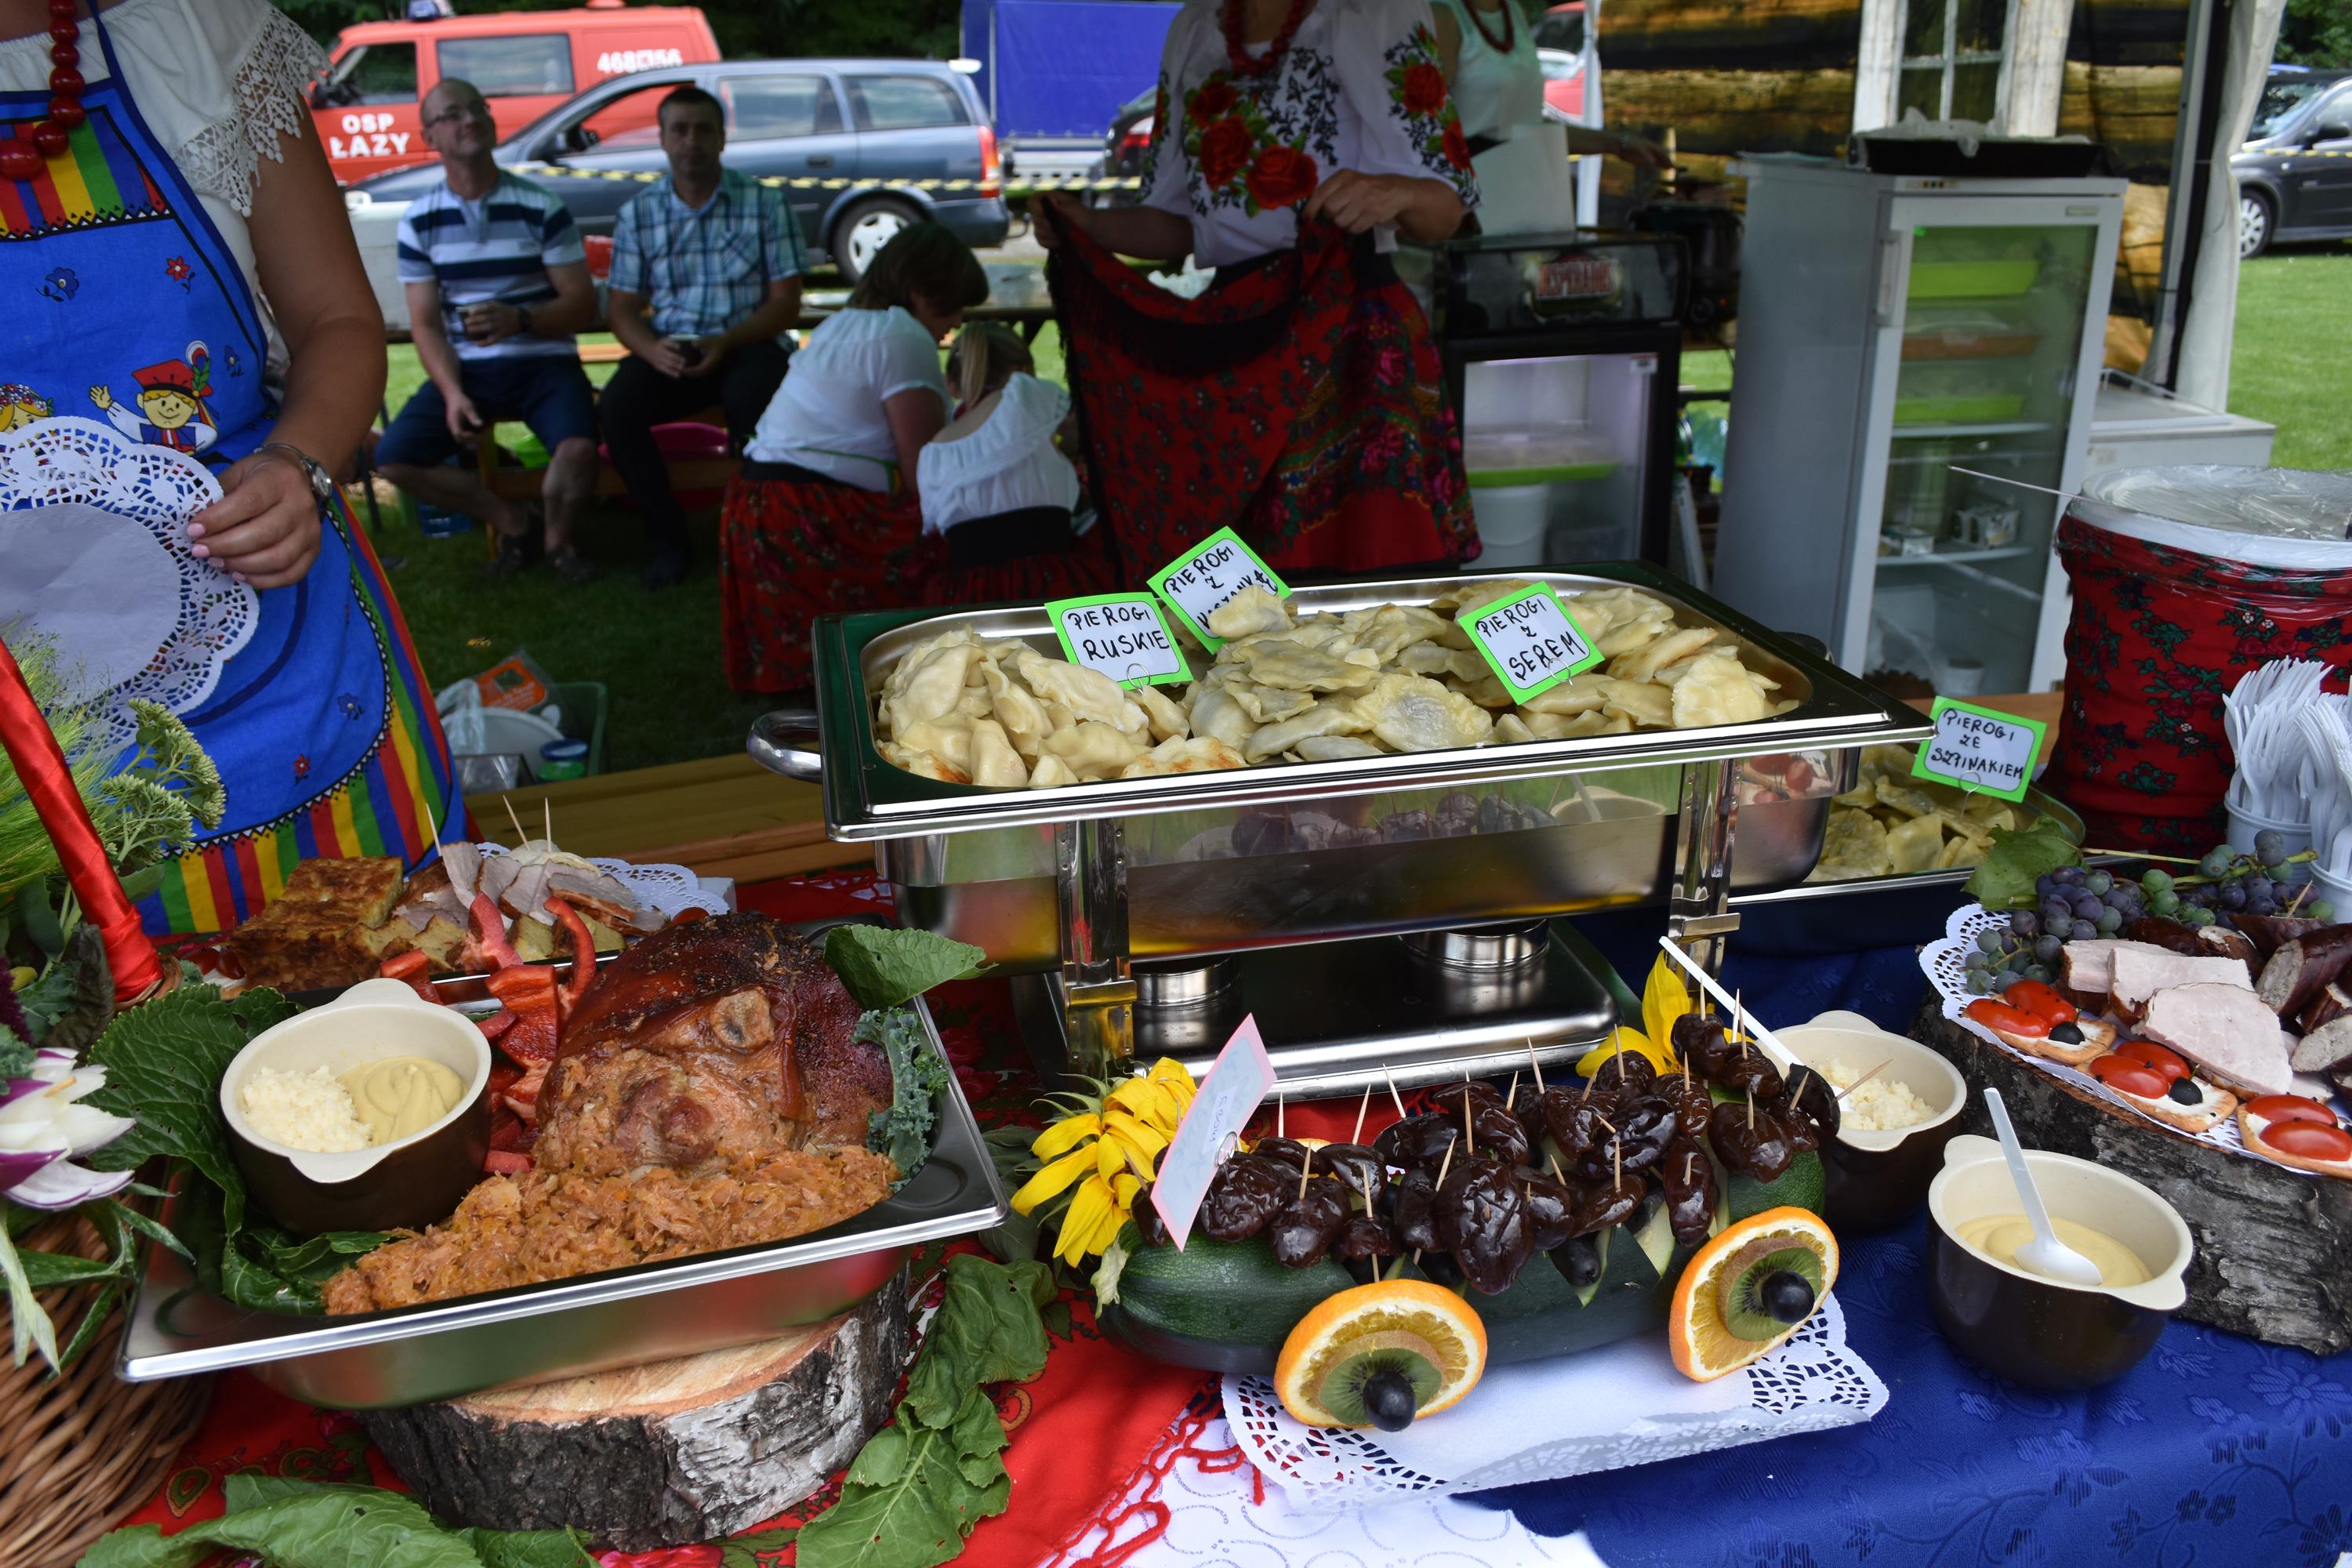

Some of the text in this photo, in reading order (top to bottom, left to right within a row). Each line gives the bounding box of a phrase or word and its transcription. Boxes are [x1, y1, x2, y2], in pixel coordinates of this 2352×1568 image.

[341, 113, 394, 134] OSP
[330, 132, 410, 158] ŁAZY
[1163, 546, 1234, 593] PIEROGI
[1068, 606, 1151, 630] PIEROGI
[1476, 598, 1547, 638] PIEROGI
[1082, 630, 1171, 661] RUSKIE
[1509, 631, 1586, 681] SEREM
[1943, 708, 2015, 742] PIEROGI
[1959, 734, 1981, 749] ZE
[1931, 747, 2024, 779] SZPINAKIEM
